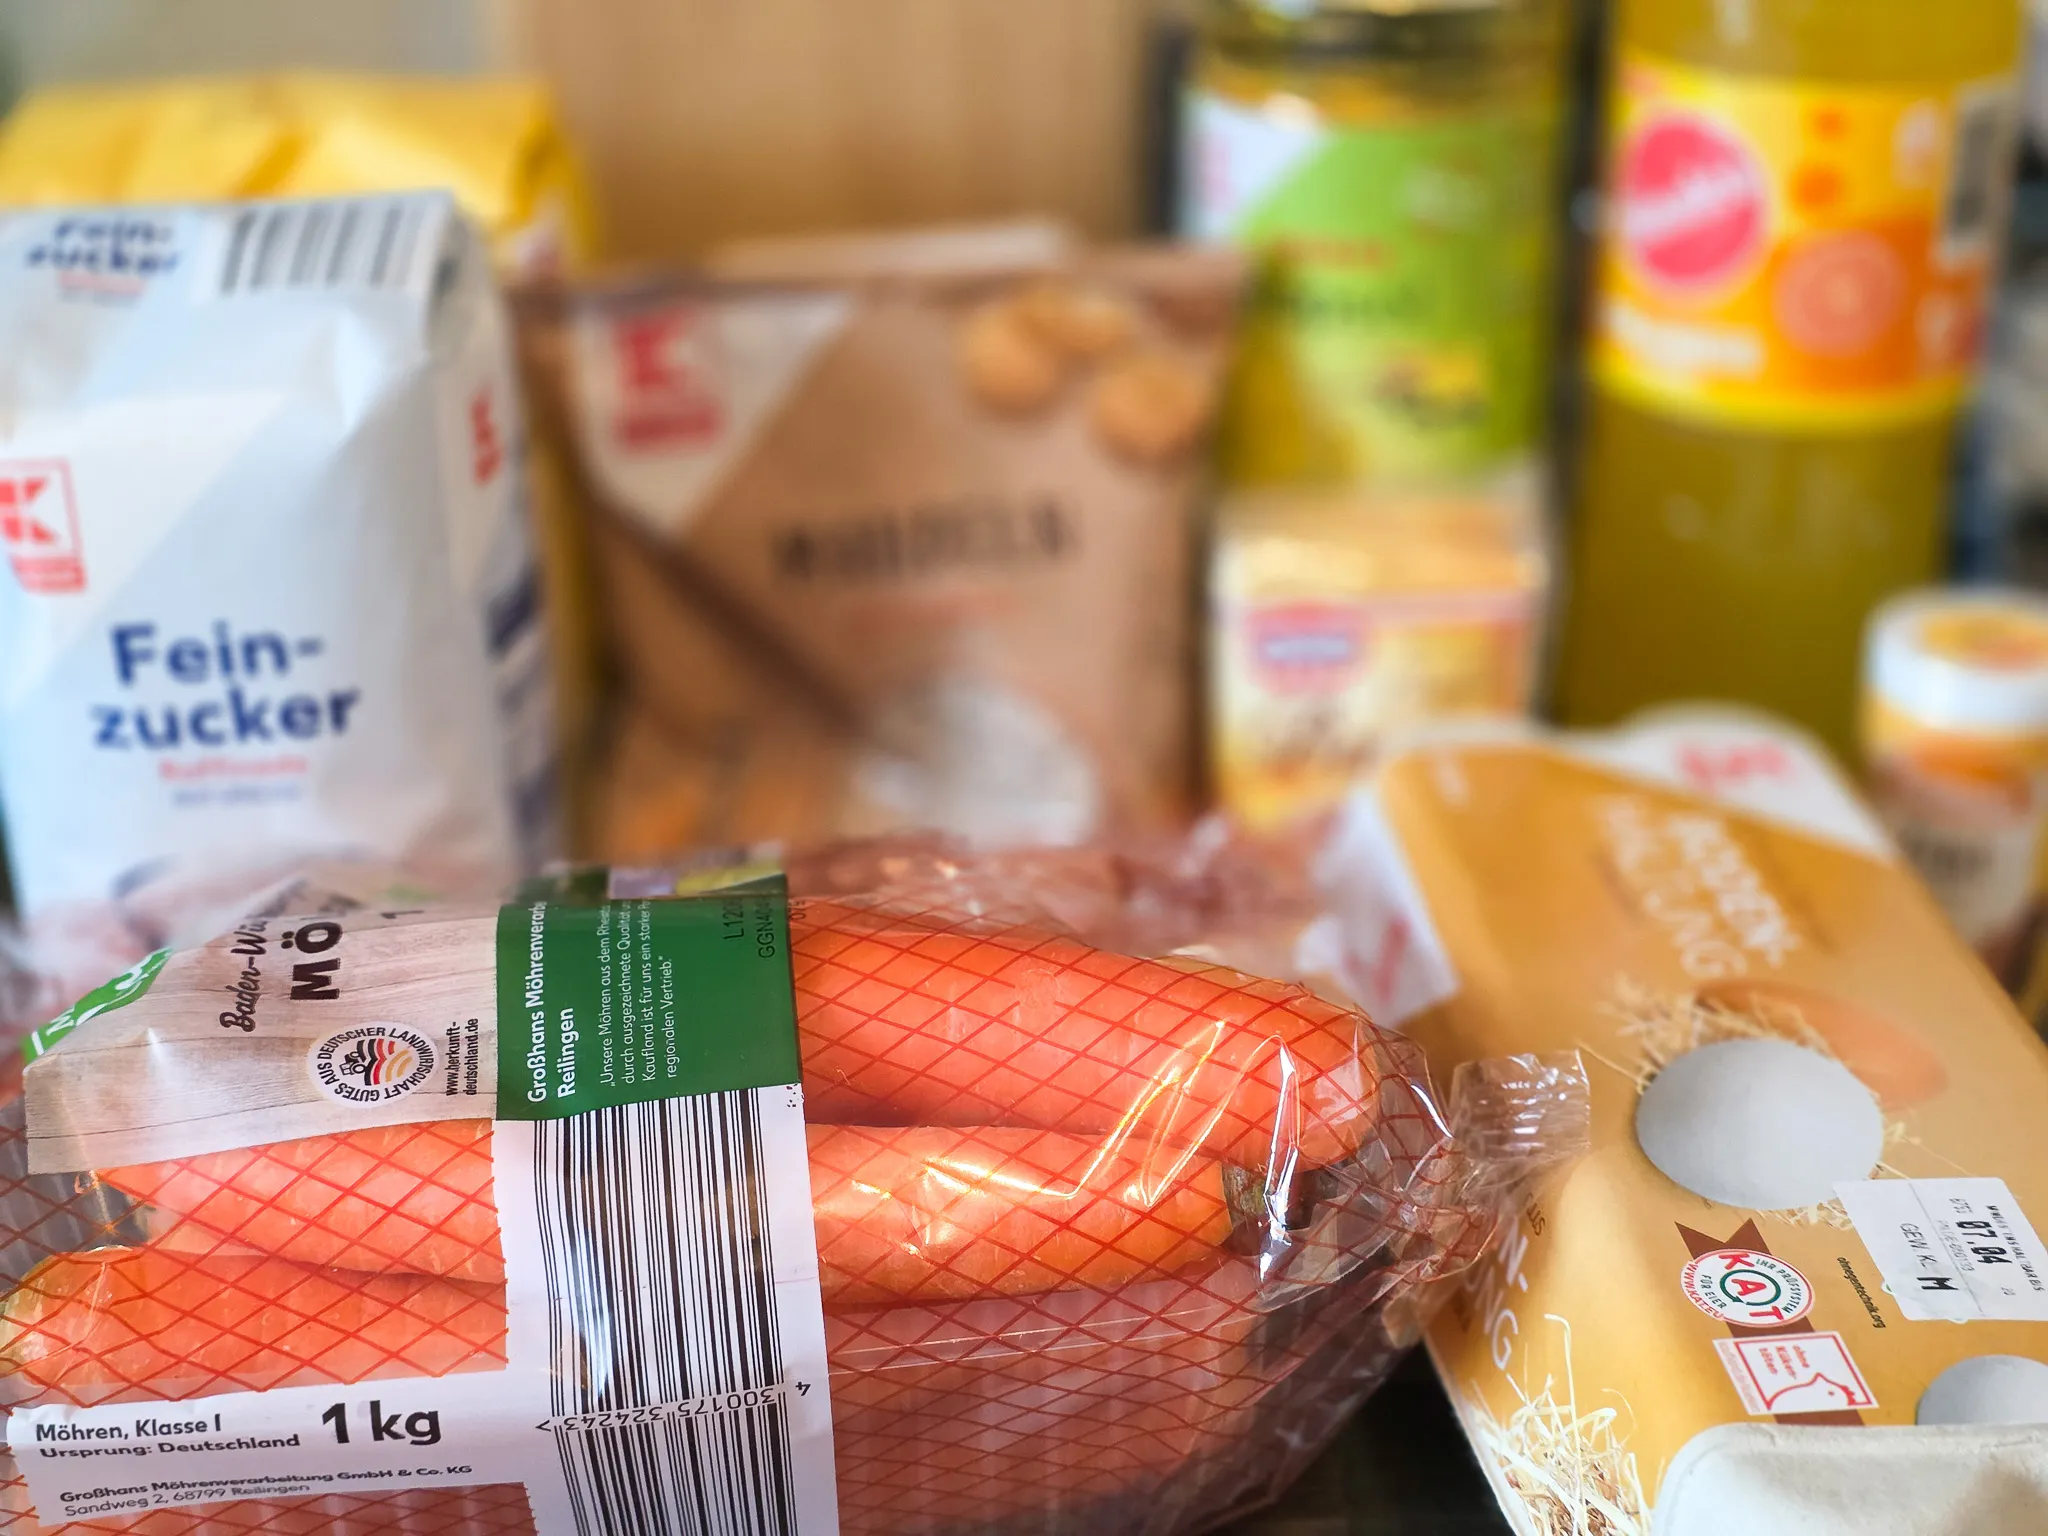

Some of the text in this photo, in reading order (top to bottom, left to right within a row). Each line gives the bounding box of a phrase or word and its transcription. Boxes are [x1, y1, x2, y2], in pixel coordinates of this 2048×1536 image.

[111, 619, 324, 688] Fein-
[93, 686, 362, 750] zucker
[617, 911, 632, 951] Qualität
[637, 912, 651, 941] starker
[281, 919, 343, 1000] MÖ
[597, 937, 611, 963] dem
[639, 942, 651, 960] ein
[219, 912, 275, 1032] Baden-Wü
[601, 966, 611, 987] aus
[641, 962, 652, 984] uns
[598, 990, 612, 1036] Möhren
[618, 952, 636, 1046] ausgezeichnete
[638, 987, 652, 1005] für
[641, 1006, 653, 1021] ist
[317, 1027, 435, 1102] GUTES AUS DEUTSCHER LANDWIRTSCHAFT
[444, 1021, 461, 1097] www.herkunft-
[463, 1018, 479, 1096] deutschland.de
[527, 1011, 547, 1103] Großhans
[557, 1008, 579, 1098] Reilingen
[642, 1022, 656, 1082] Kaufland
[661, 1011, 677, 1079] regionalen
[620, 1050, 635, 1084] durch
[1755, 1258, 1777, 1271] IHR
[1916, 1276, 1960, 1291] M
[1705, 1290, 1728, 1309] EIER
[1836, 1256, 1887, 1328] ohnegentechnik.org
[36, 1413, 222, 1442] Möhren, Klasse I
[322, 1400, 442, 1446] 1 kg
[563, 1381, 812, 1431] 4 300175 324243
[39, 1434, 300, 1458] Ursprung: Deutschland
[59, 1465, 473, 1502] Großhans Möhrenverarbeitung GmbH & Co. KG
[64, 1483, 310, 1517] Sandweg 2, 68799 Reilingen
